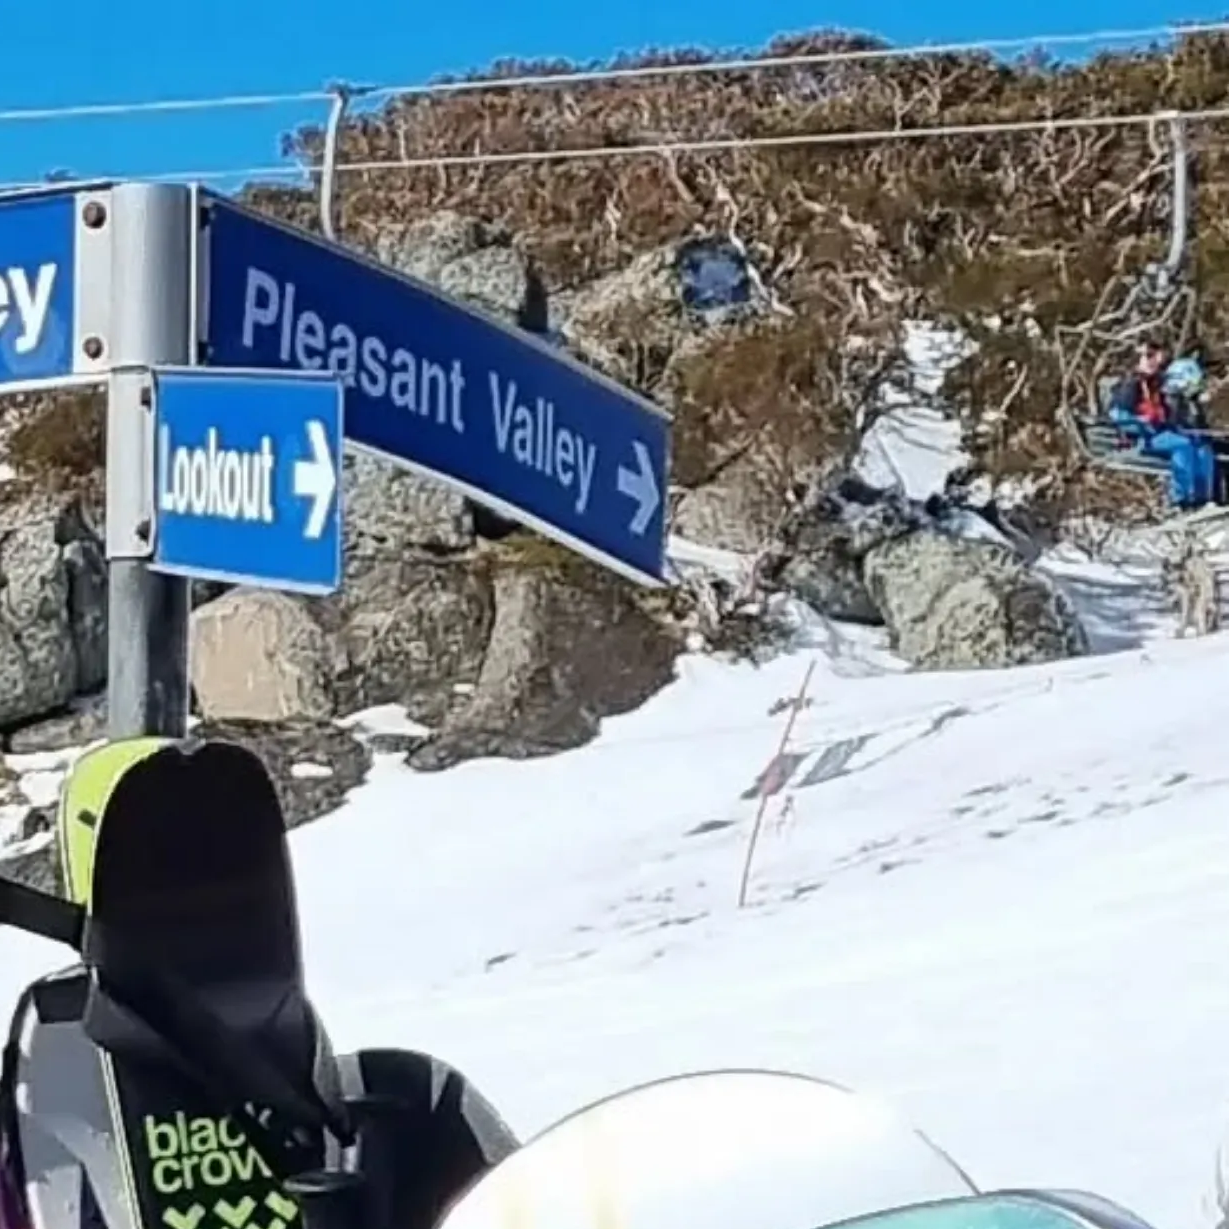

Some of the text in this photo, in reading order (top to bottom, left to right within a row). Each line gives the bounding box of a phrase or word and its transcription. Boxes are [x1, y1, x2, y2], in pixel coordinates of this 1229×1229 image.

[242, 267, 597, 515] Pleasant Valley
[160, 424, 275, 523] Lookout
[144, 1110, 246, 1159] blac
[152, 1146, 273, 1193] crow
